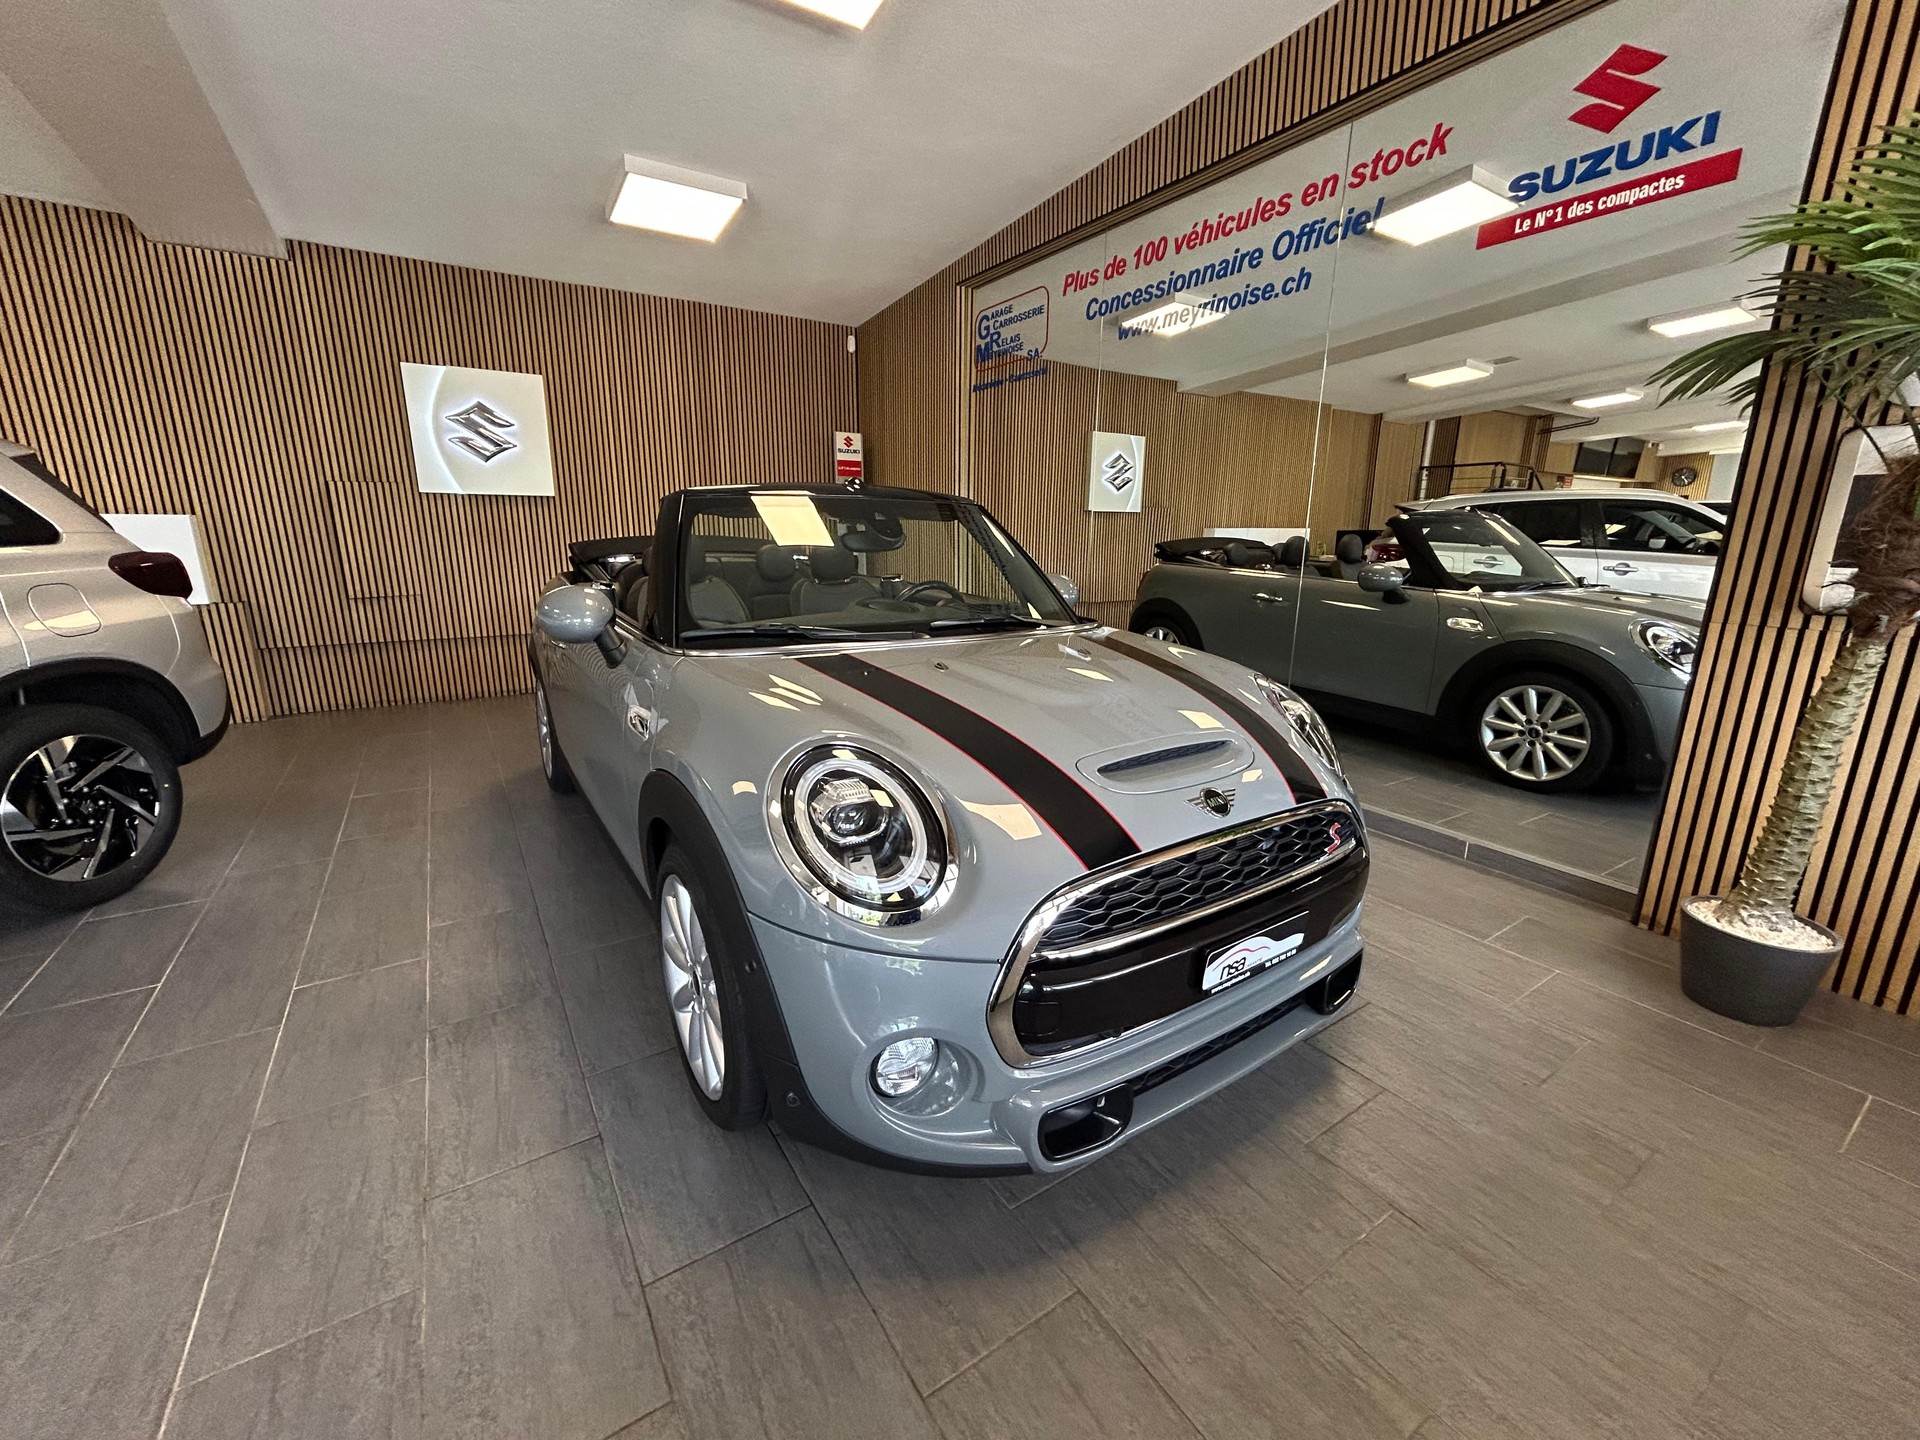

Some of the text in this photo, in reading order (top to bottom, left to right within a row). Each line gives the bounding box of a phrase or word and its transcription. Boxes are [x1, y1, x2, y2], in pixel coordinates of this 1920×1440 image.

[1507, 110, 1721, 204] SUZUKI
[1062, 122, 1454, 297] Plus de 100 véhicules en stock
[1514, 218, 1531, 234] Le
[1567, 200, 1594, 219] des
[1597, 174, 1685, 210] compactes
[1086, 196, 1385, 320] Concessionnaire Officiel
[989, 330, 1021, 351] RELAIS
[993, 304, 1045, 331] CARROSSERIE
[1118, 267, 1312, 341] www.meyrinoise.ch
